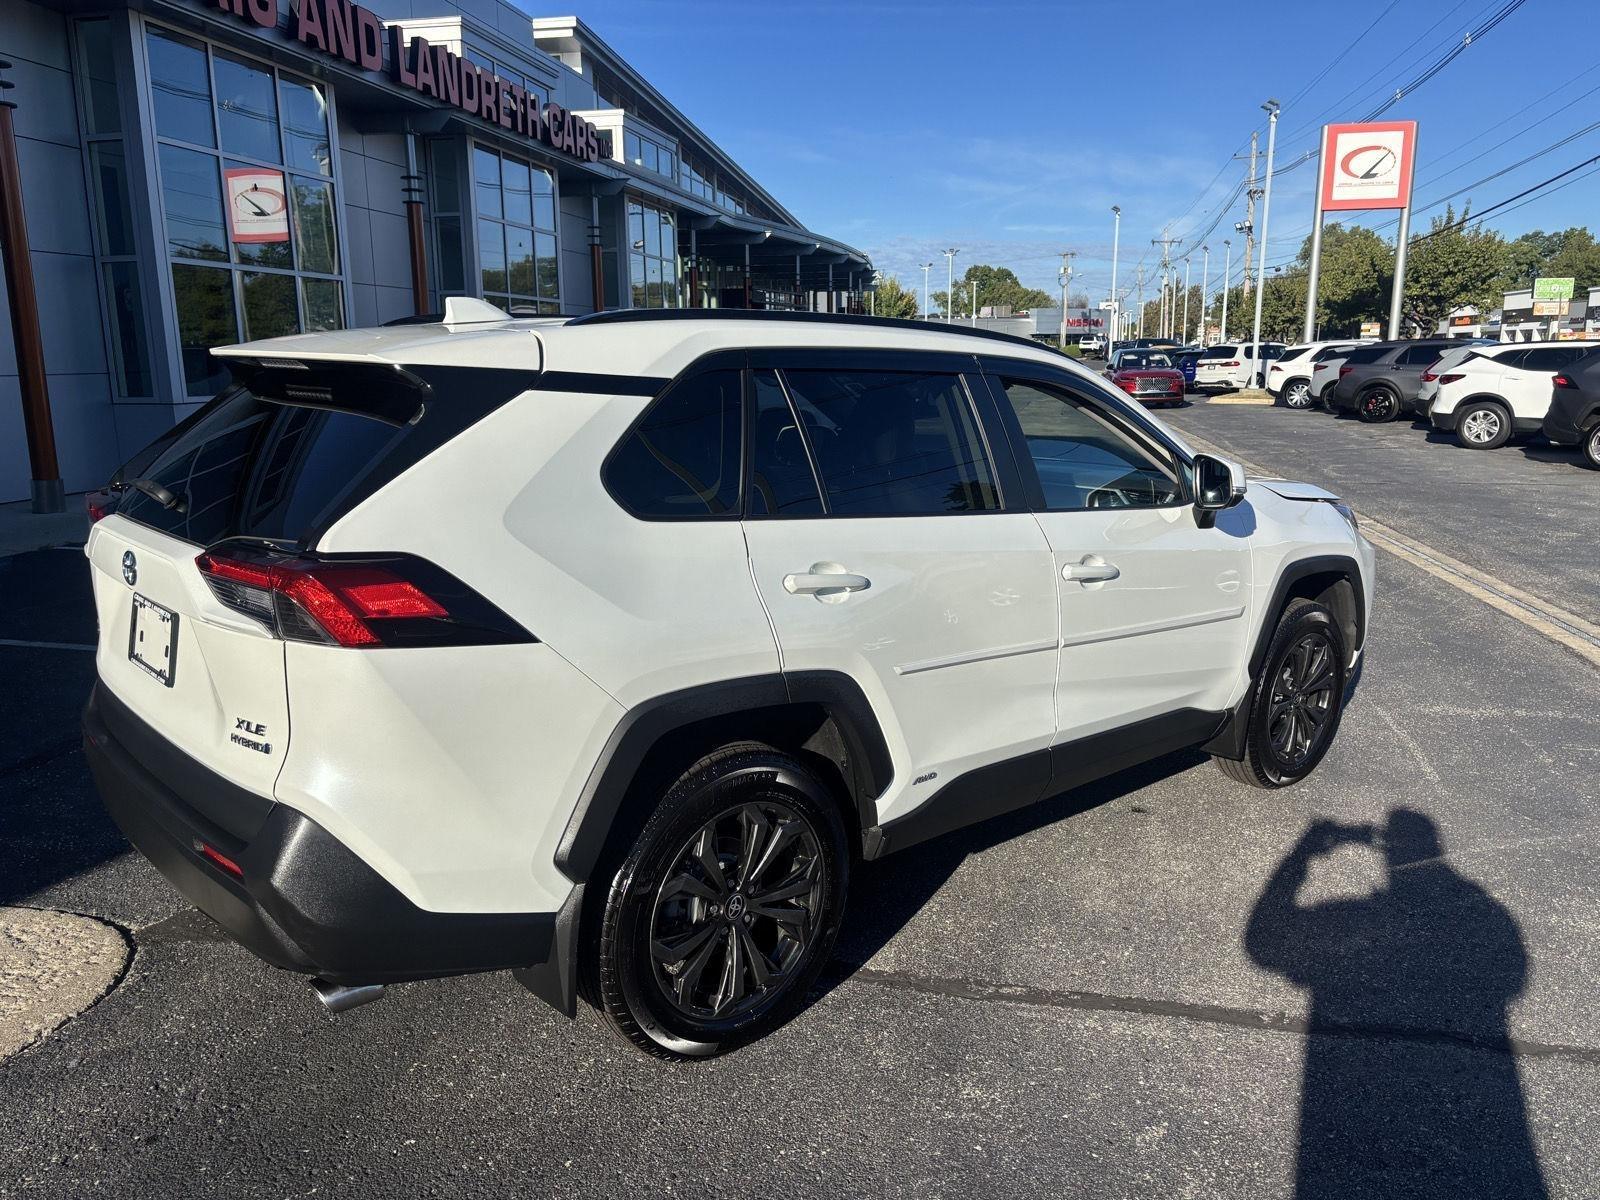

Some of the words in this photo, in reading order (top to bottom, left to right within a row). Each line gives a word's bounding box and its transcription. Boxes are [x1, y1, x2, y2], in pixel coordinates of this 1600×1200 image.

[297, 0, 382, 72] AND
[391, 25, 542, 140] LANDRETH
[546, 102, 599, 163] CARS
[1066, 318, 1104, 328] NISSAN
[235, 717, 267, 736] XLE
[230, 733, 264, 753] HYBRID
